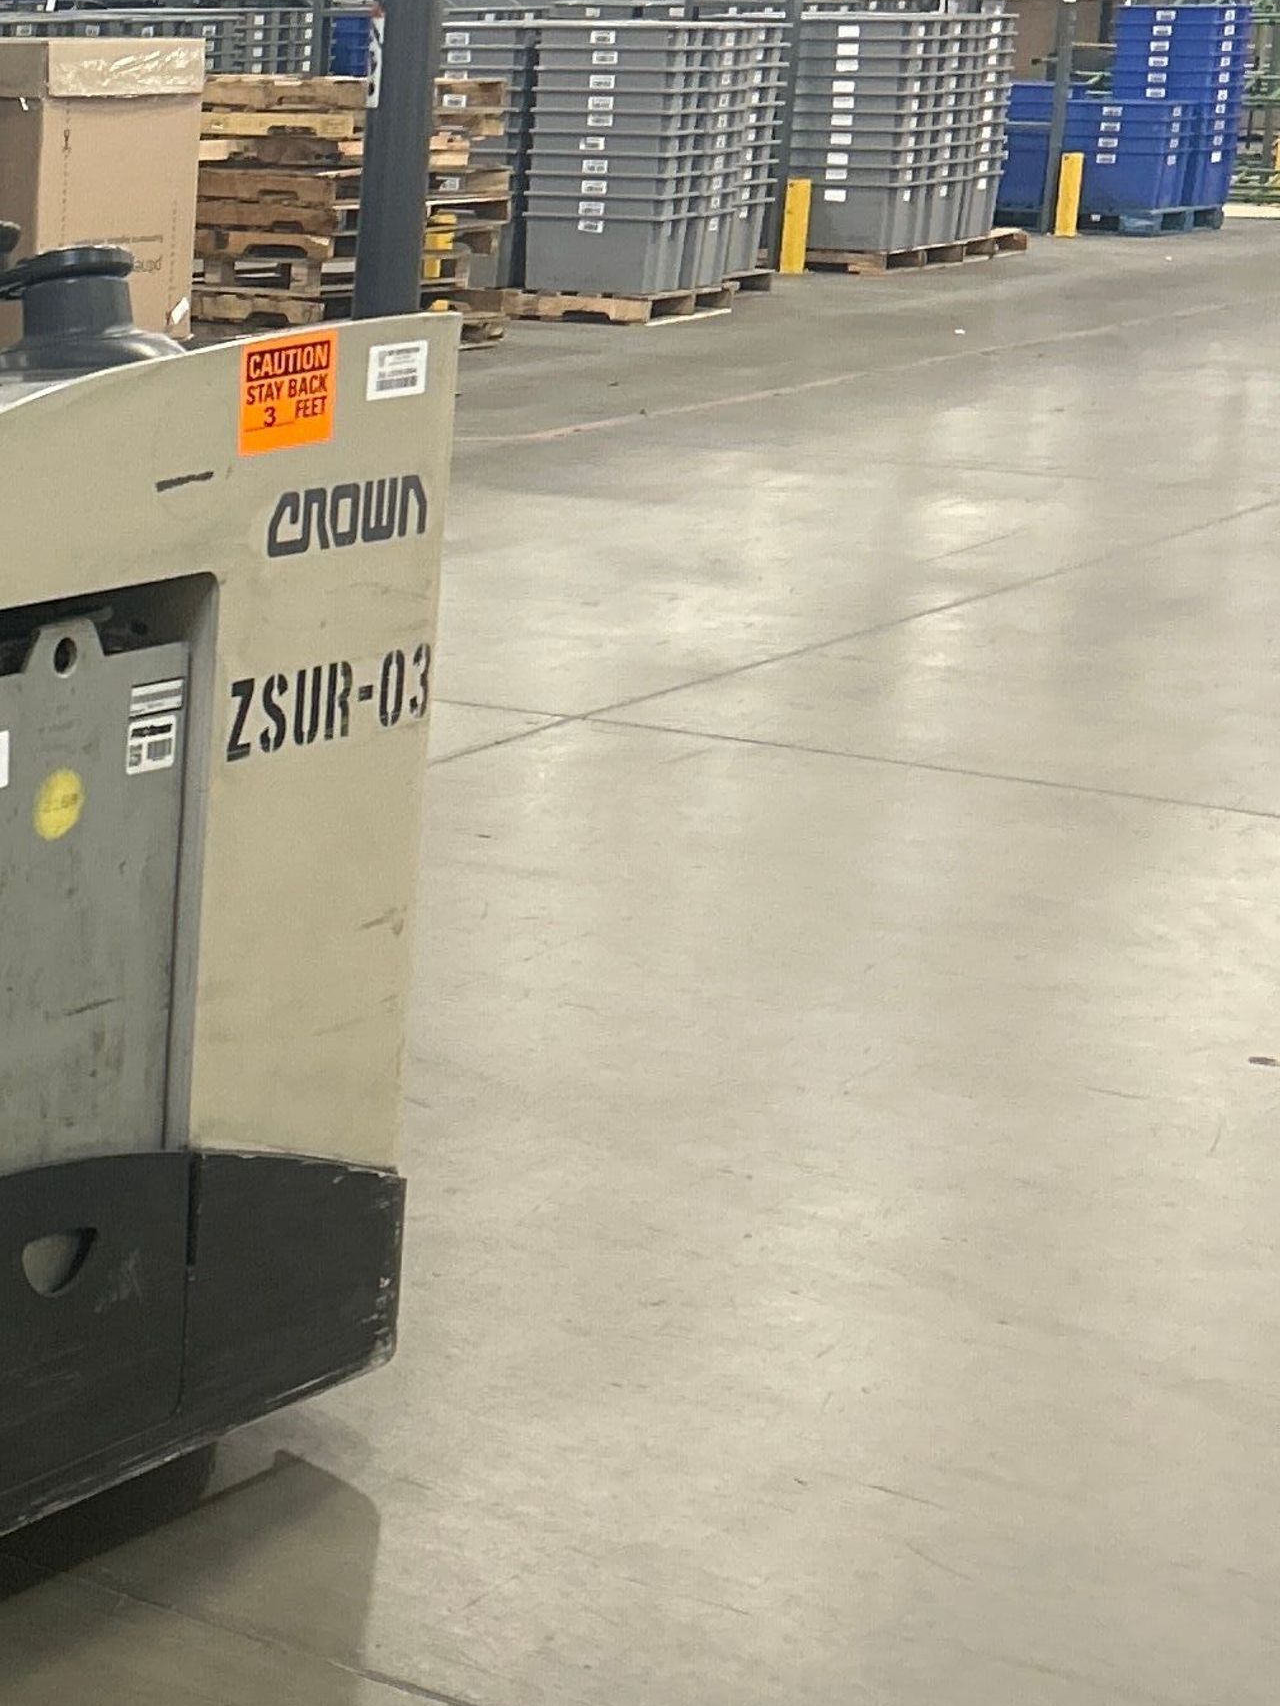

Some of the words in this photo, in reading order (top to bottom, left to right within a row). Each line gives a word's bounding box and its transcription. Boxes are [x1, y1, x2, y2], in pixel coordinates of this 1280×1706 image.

[249, 343, 329, 379] CAUTION
[246, 380, 285, 405] STAY
[288, 373, 328, 398] BACK
[263, 406, 276, 427] 3
[295, 396, 327, 420] FEET
[267, 475, 427, 557] CROWN
[226, 643, 431, 762] ZSUR-03
